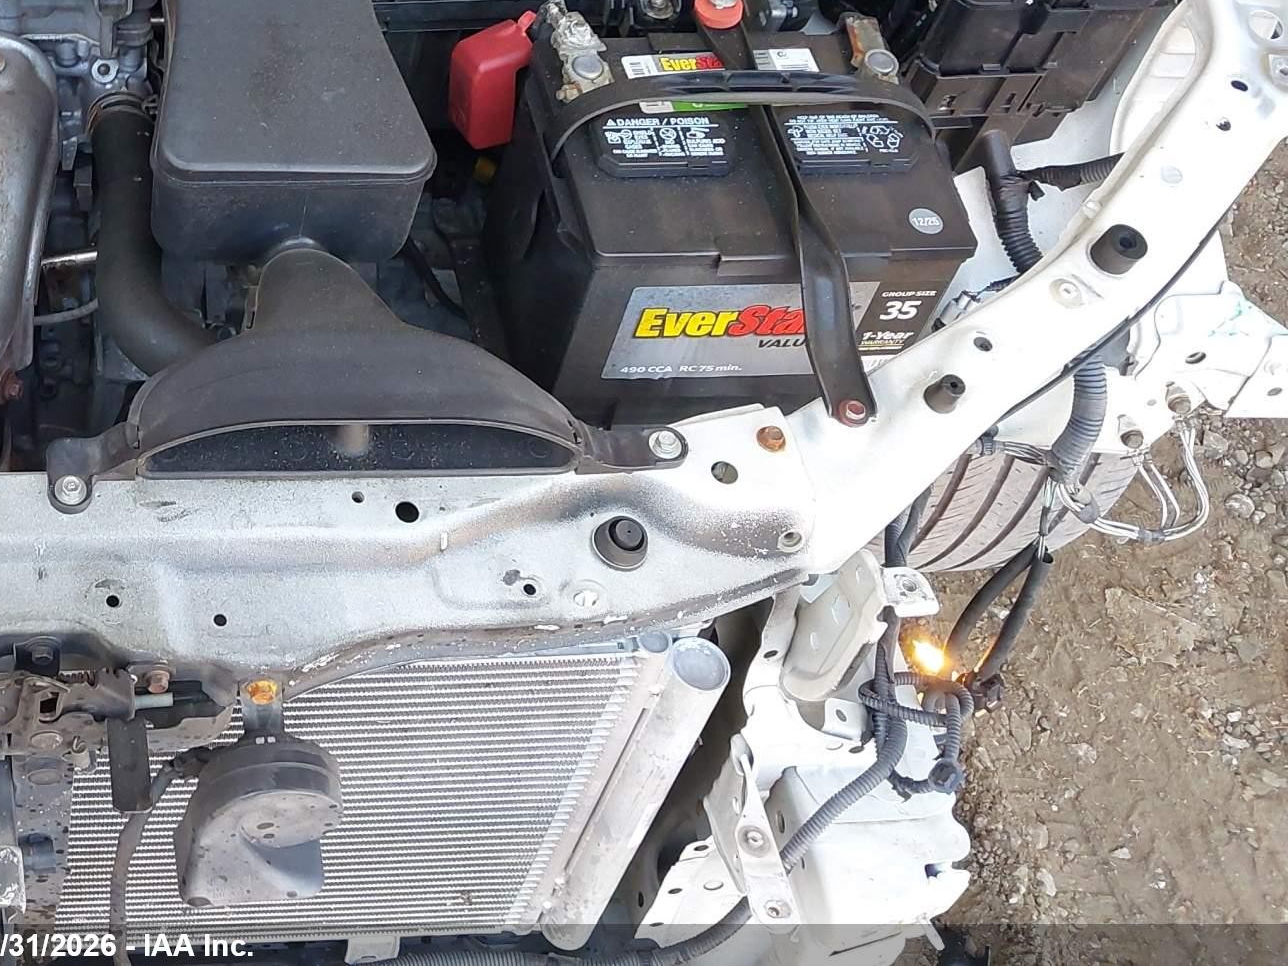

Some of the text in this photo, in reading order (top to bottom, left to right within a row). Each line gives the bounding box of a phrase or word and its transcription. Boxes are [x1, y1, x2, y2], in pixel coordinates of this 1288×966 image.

[617, 118, 660, 126] DANGER
[671, 117, 710, 125] POISON
[879, 300, 922, 321] 35
[862, 331, 914, 340] 1-Year
[647, 365, 673, 373] CCA
[717, 363, 743, 371] min.
